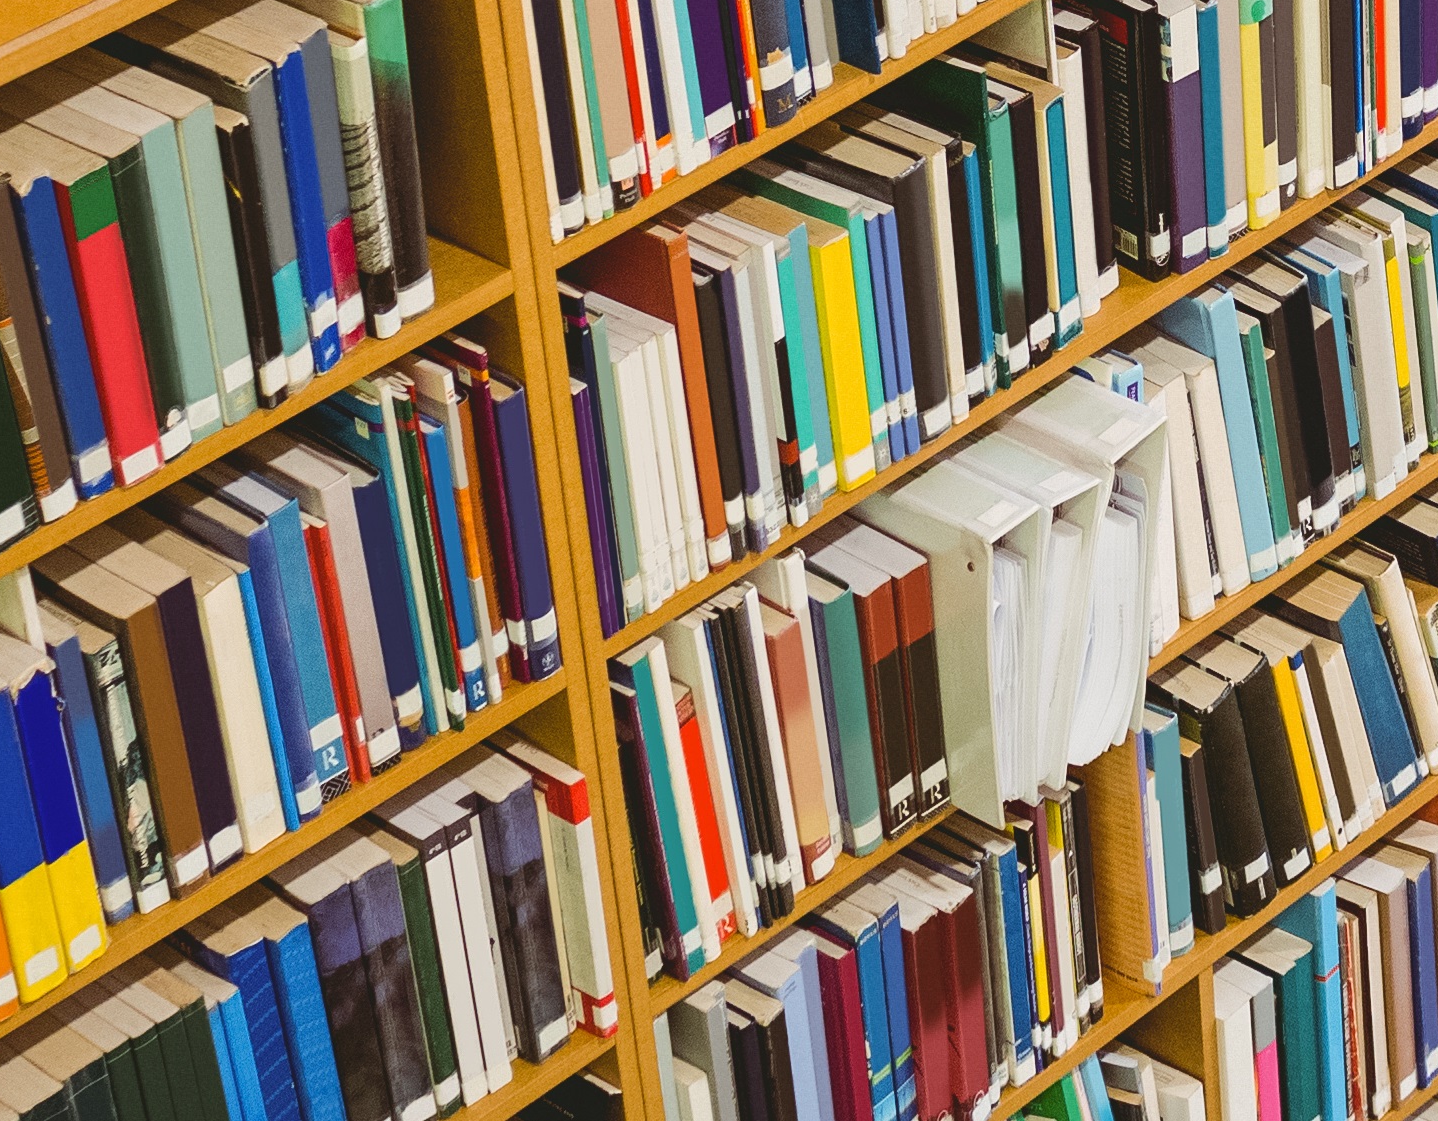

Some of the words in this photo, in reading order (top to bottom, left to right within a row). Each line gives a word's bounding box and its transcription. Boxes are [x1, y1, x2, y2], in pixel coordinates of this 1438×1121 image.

[472, 681, 485, 700] R
[322, 746, 338, 771] R
[898, 799, 910, 821] R
